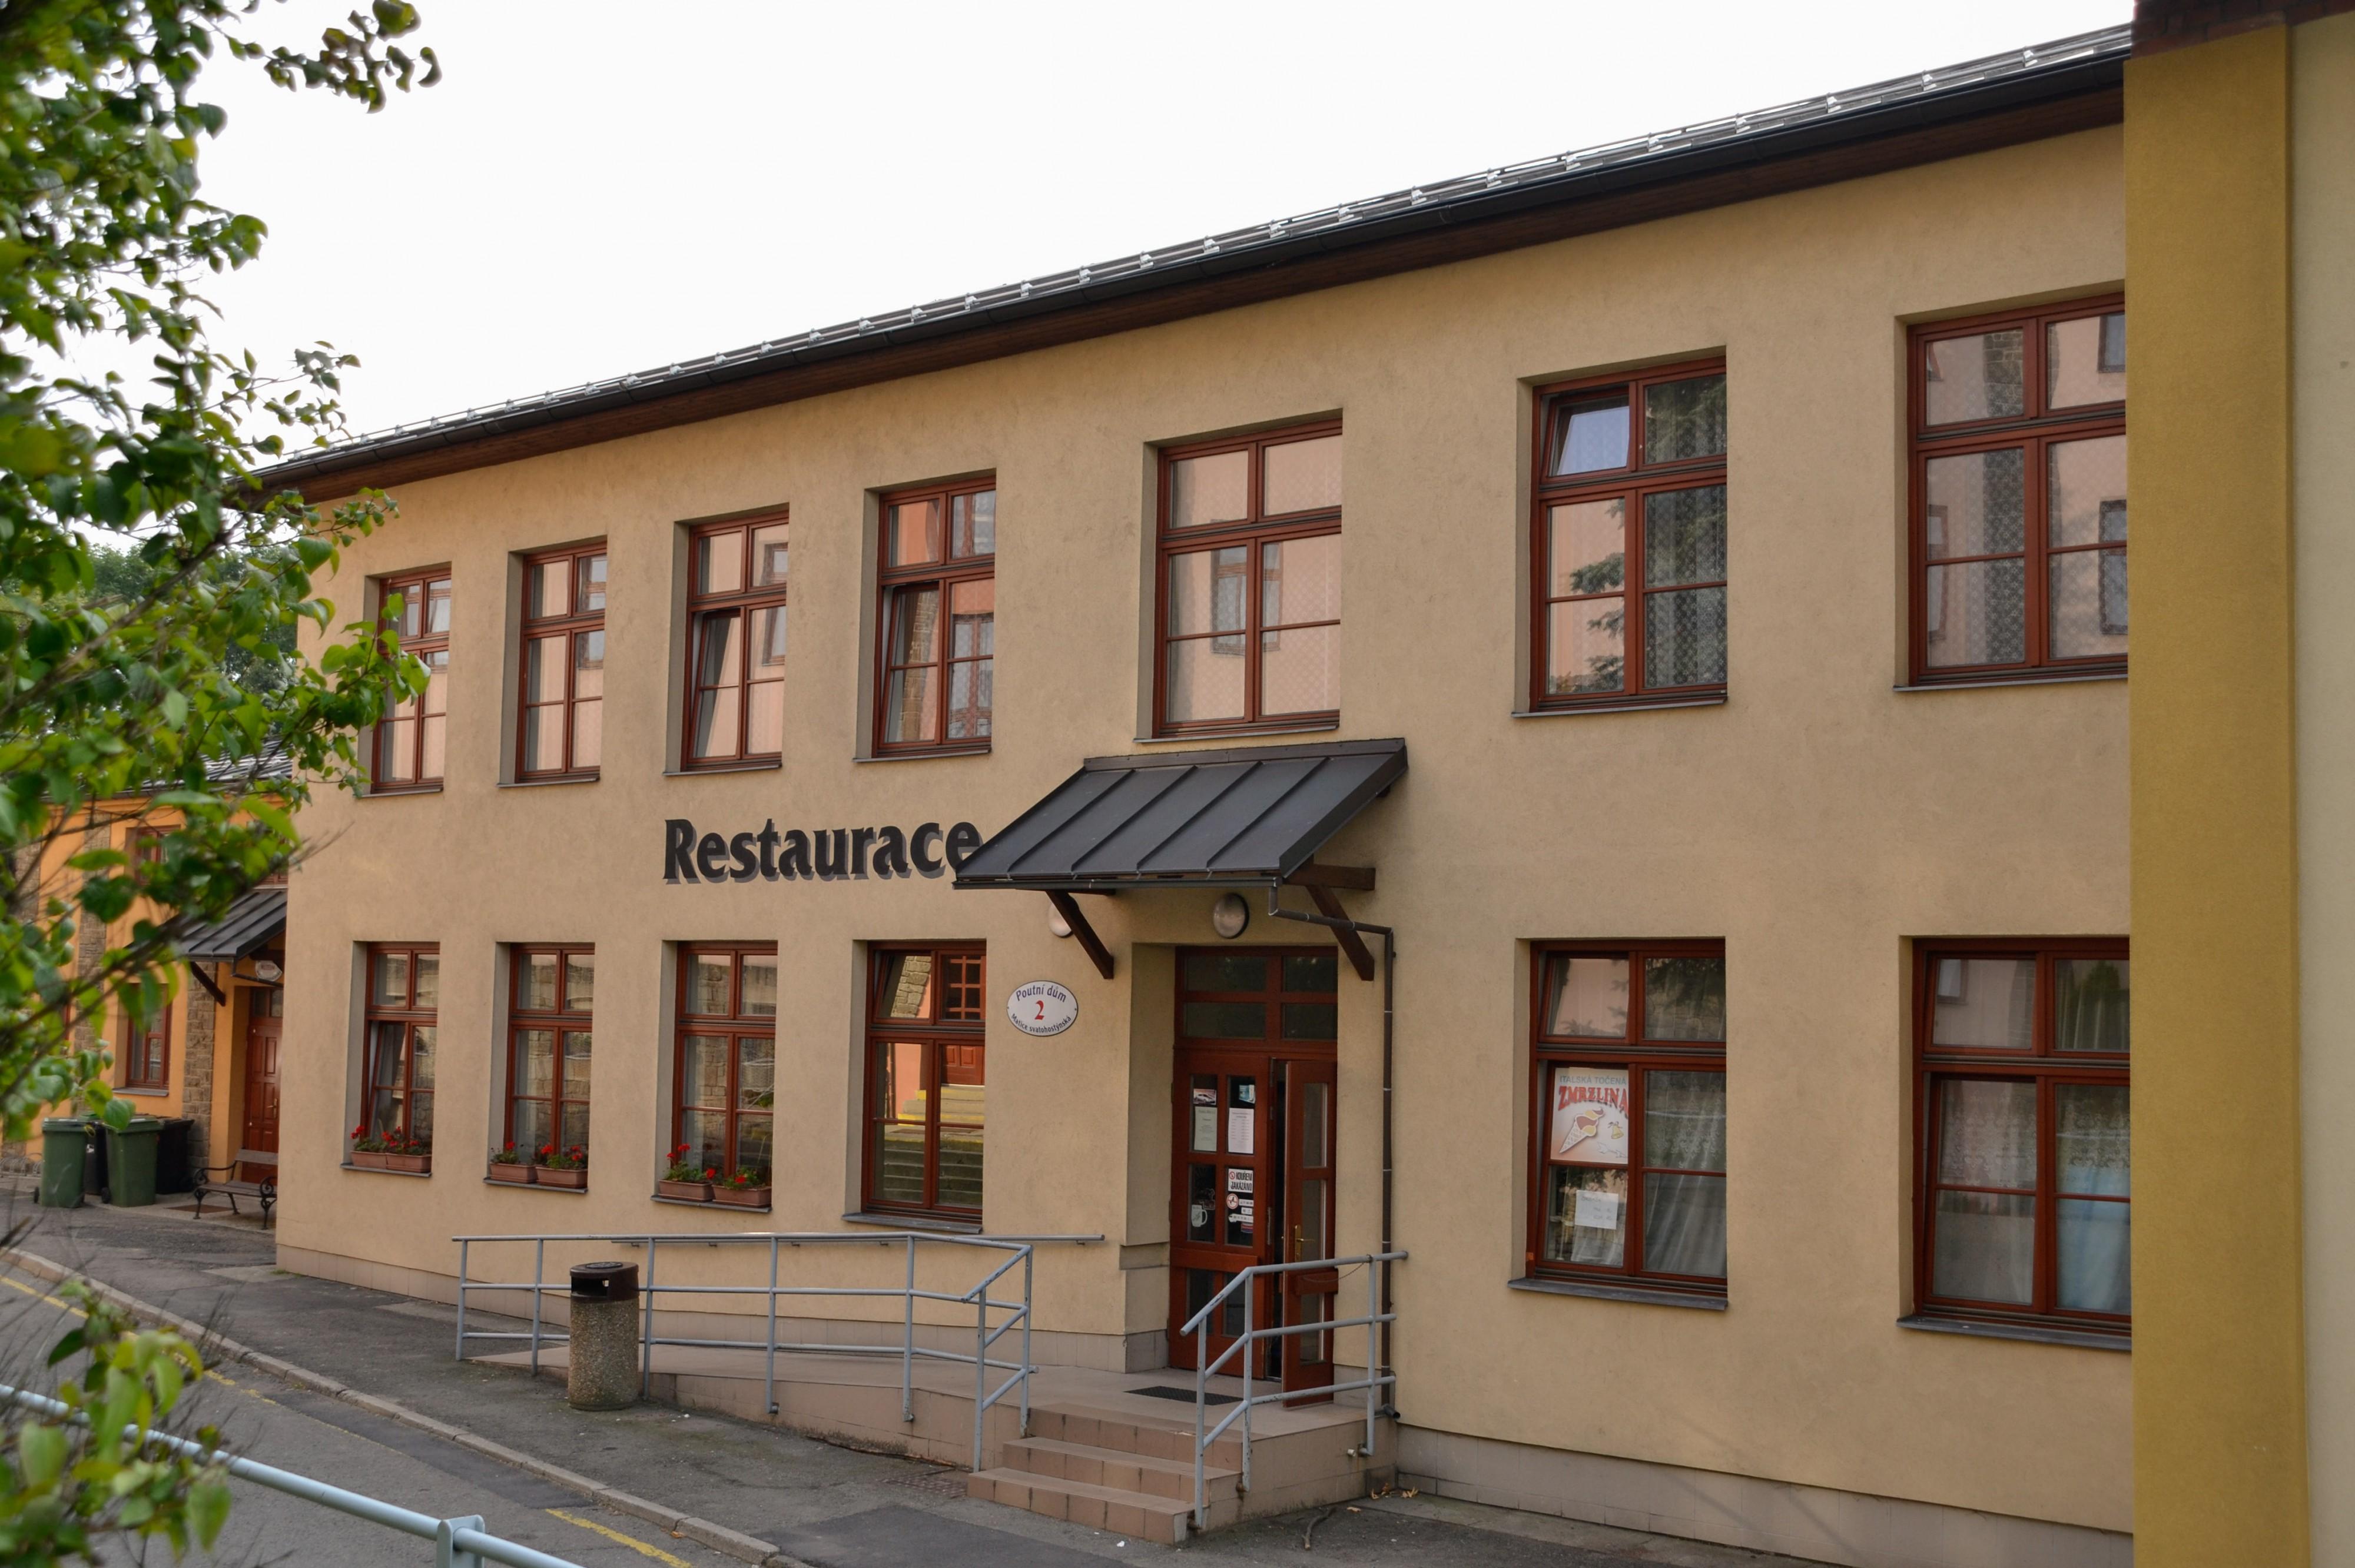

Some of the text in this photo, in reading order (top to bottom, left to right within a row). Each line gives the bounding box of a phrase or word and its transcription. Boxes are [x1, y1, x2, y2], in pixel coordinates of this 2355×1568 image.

[663, 818, 983, 884] Restaurace
[1016, 984, 1066, 1002] Poutní dům
[1034, 999, 1045, 1020] 2
[1011, 1013, 1072, 1033] Matice svatohostýnská
[1560, 1075, 1627, 1085] ITALSKÁ TOČENÁ
[1557, 1085, 1628, 1115] ZMRZLINA
